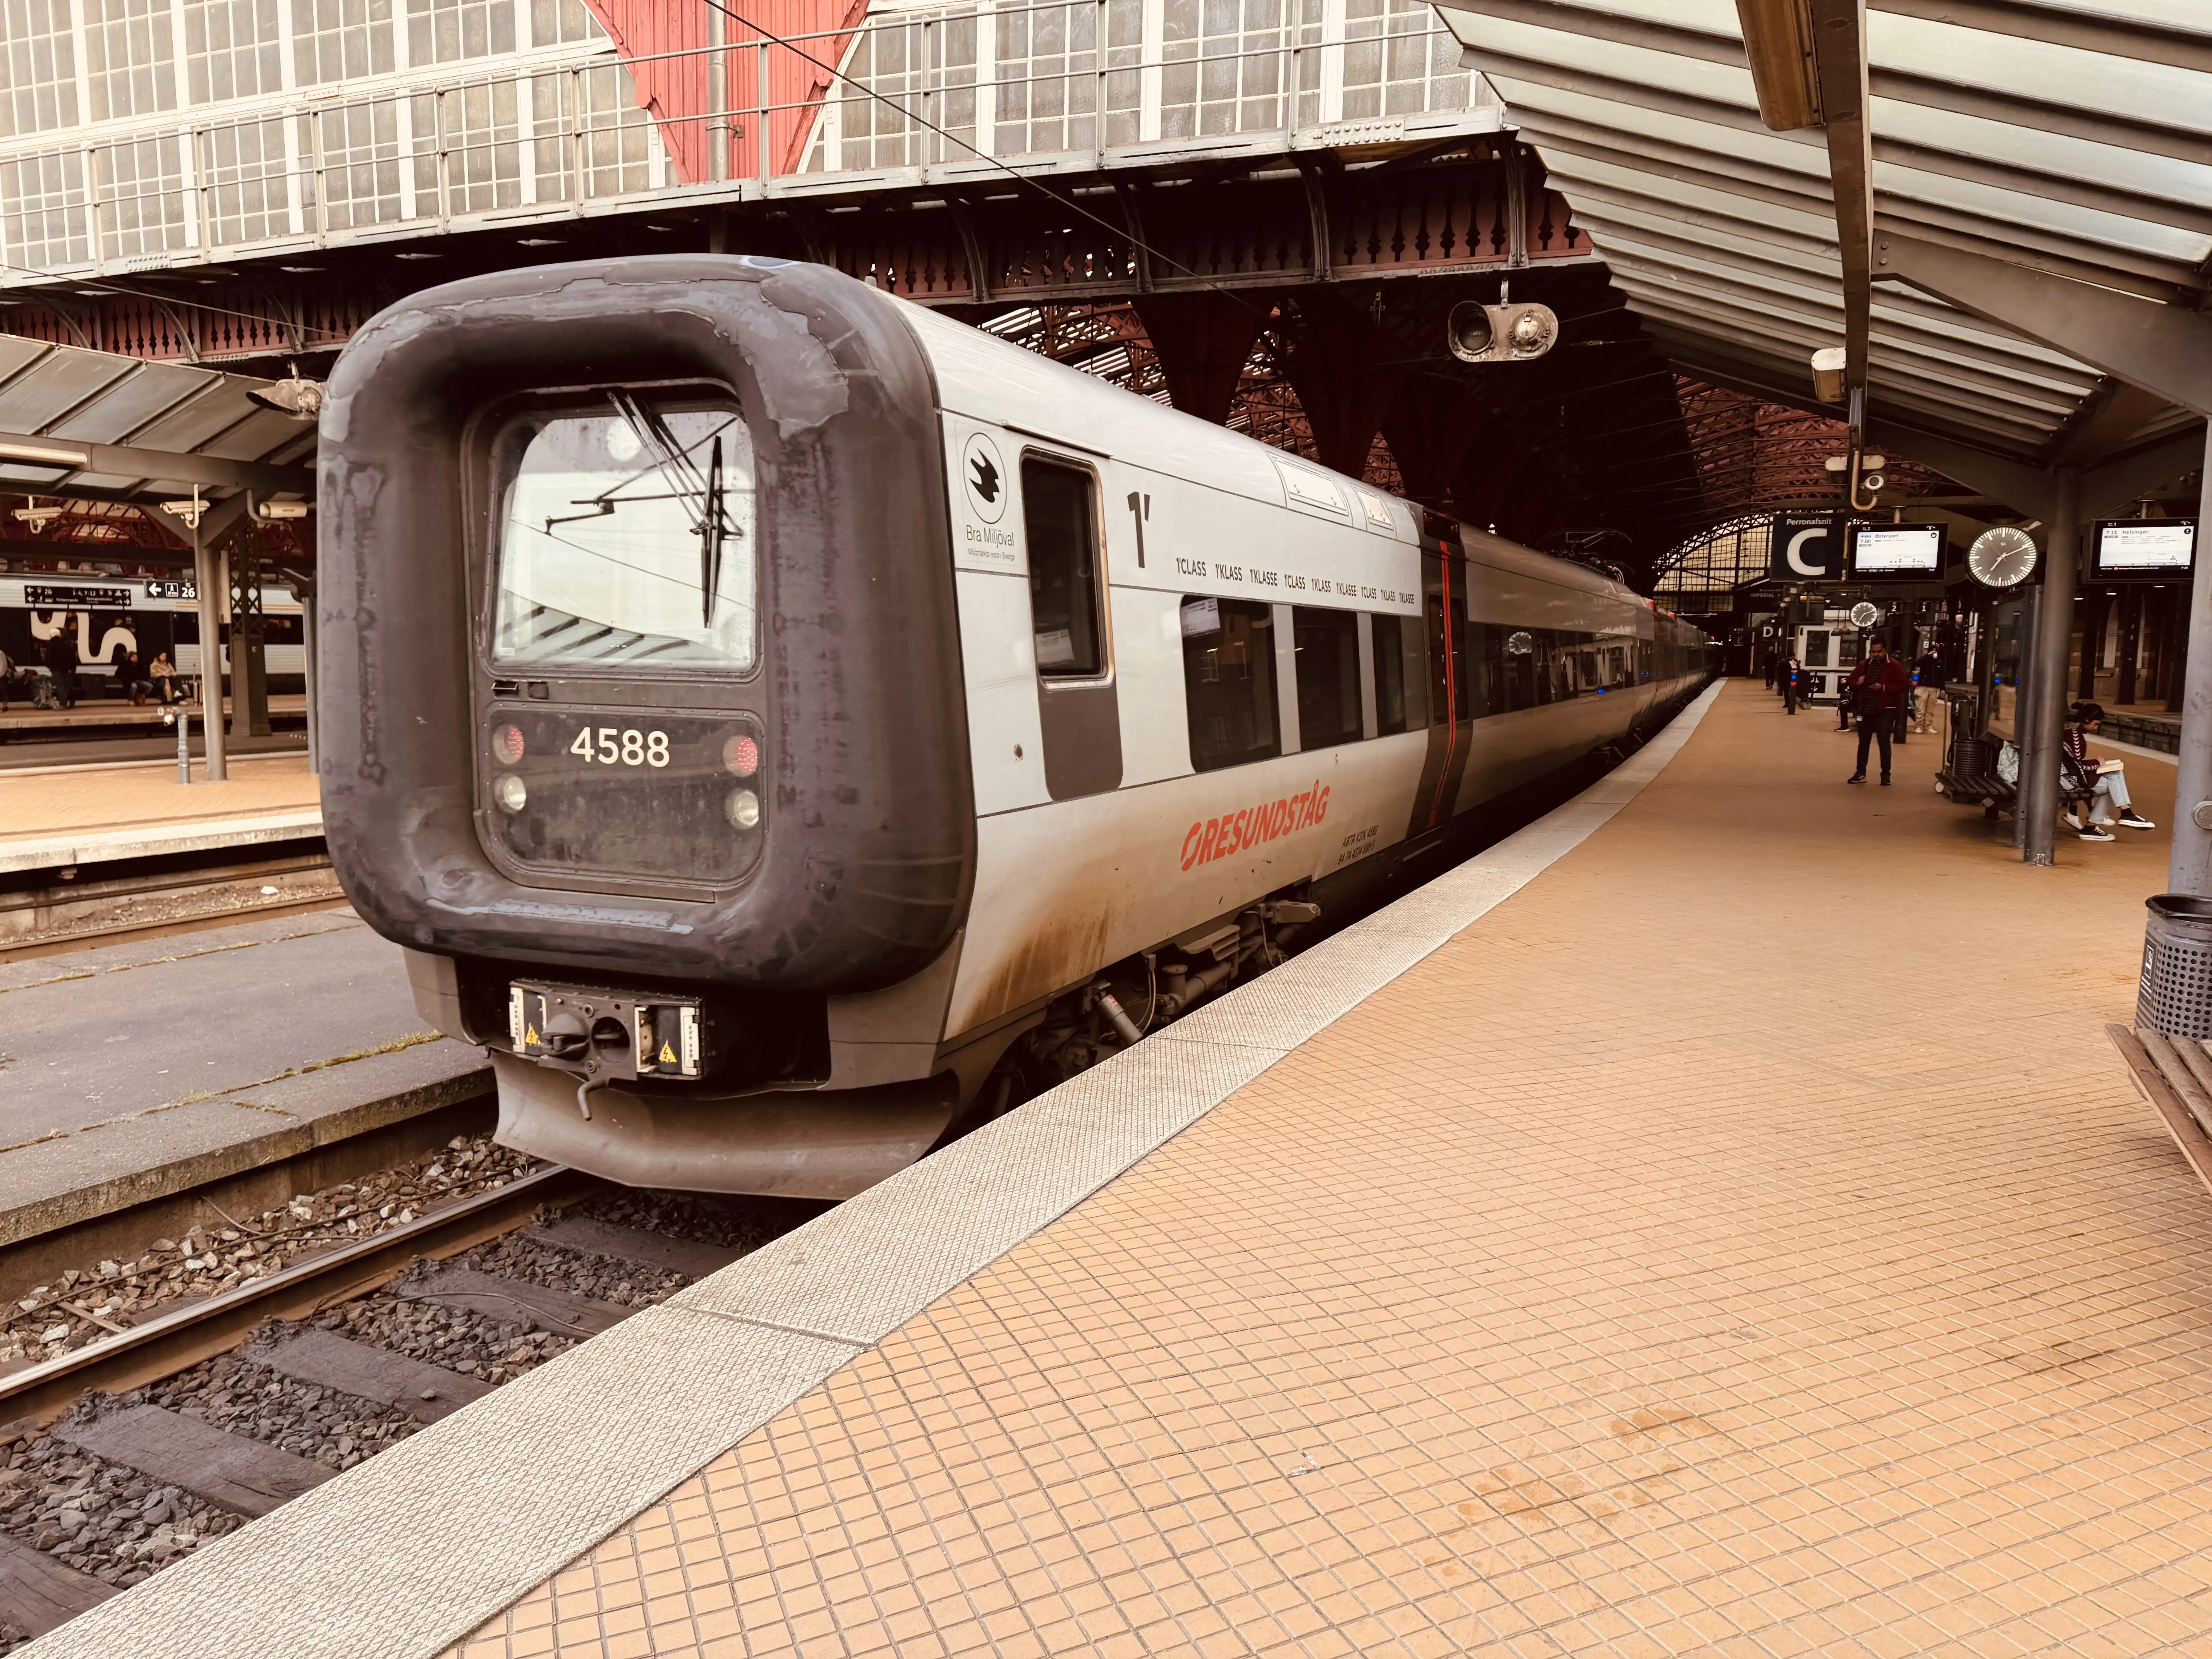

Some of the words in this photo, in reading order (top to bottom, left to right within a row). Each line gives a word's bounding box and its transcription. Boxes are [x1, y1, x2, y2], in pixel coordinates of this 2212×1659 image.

[966, 525, 982, 542] Bra
[984, 527, 1014, 548] Miljöval
[1787, 528, 1827, 575] C
[182, 587, 195, 598] 26
[1763, 626, 1773, 637] D
[570, 727, 670, 767] 4588
